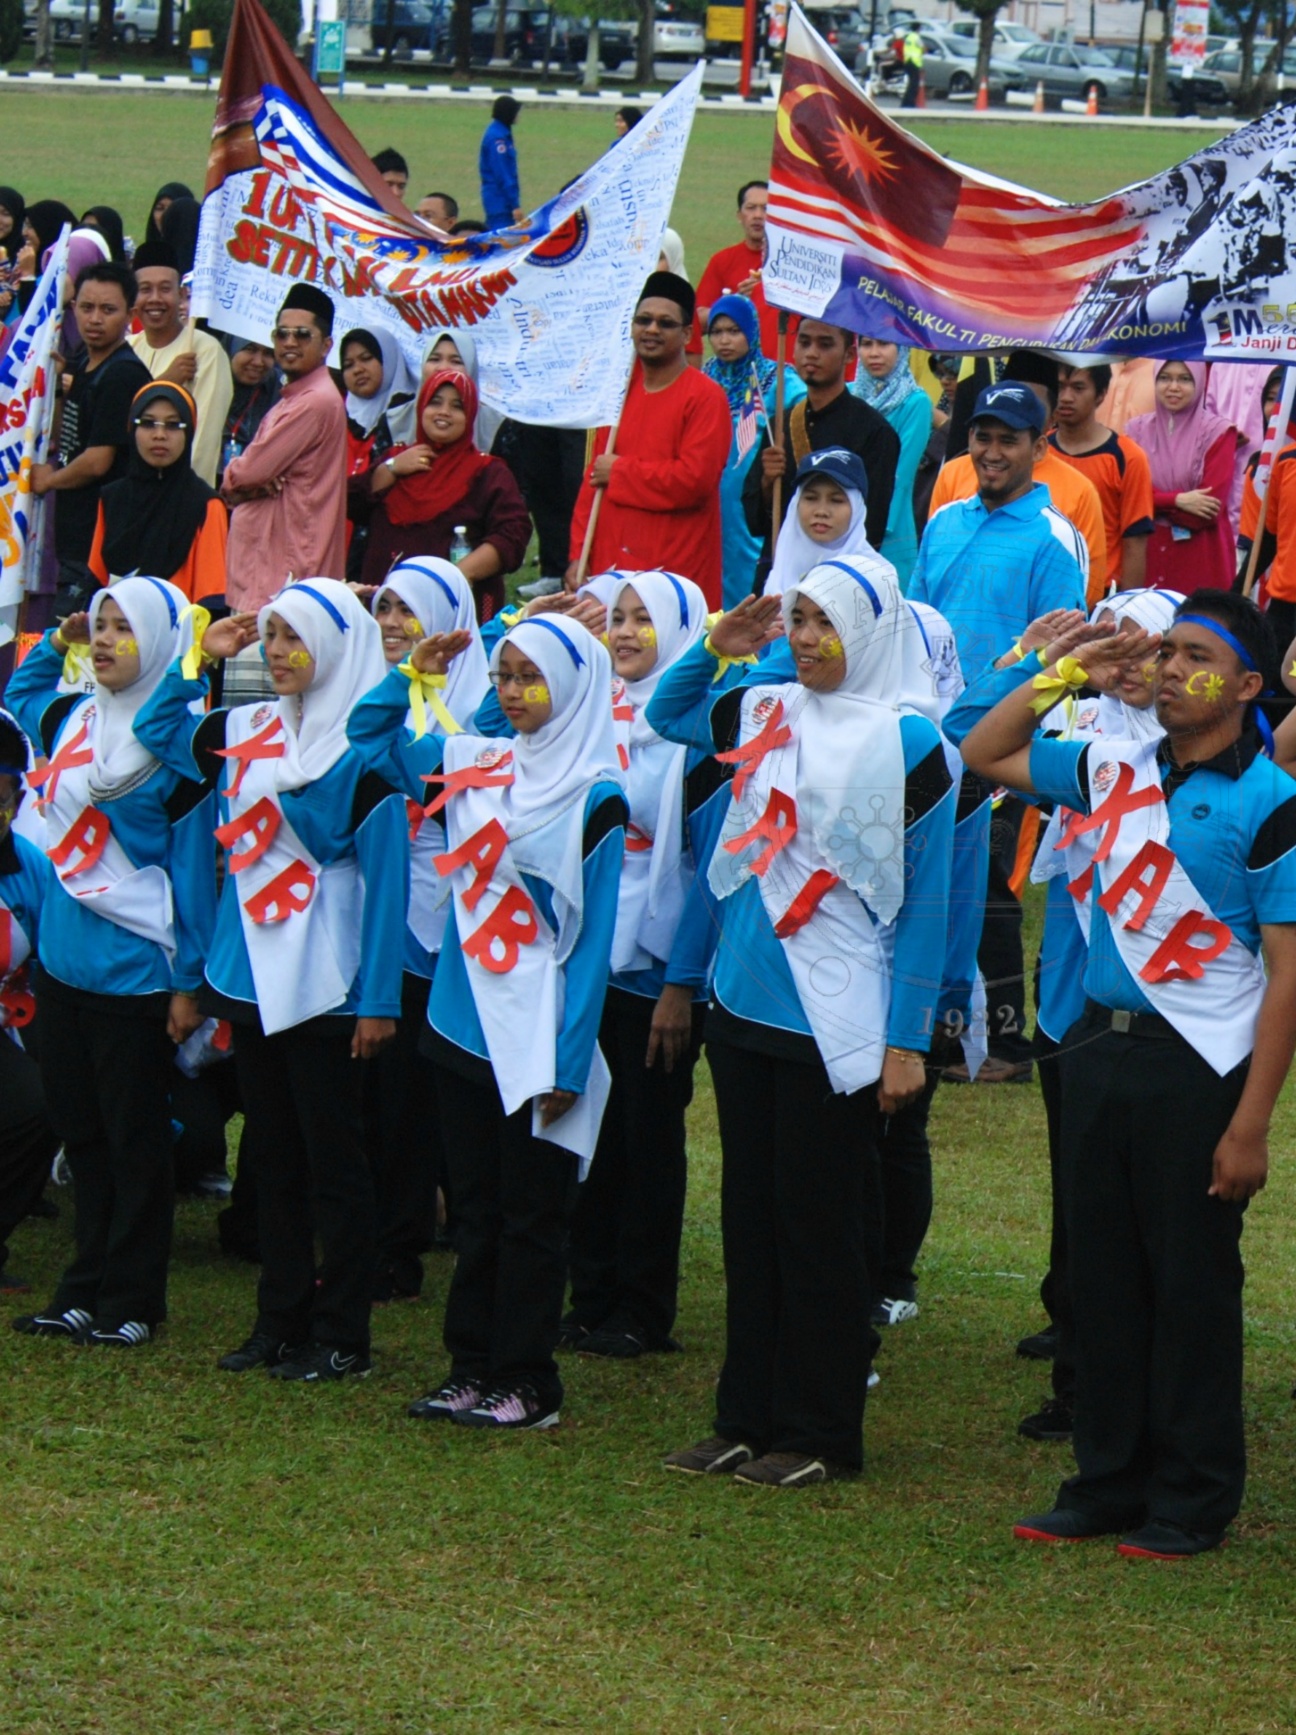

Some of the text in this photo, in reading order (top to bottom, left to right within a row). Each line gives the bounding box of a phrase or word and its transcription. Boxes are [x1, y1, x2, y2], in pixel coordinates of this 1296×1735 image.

[768, 261, 808, 285] SULTAN
[907, 305, 976, 344] FAKULTI
[1241, 336, 1281, 352] Janji
